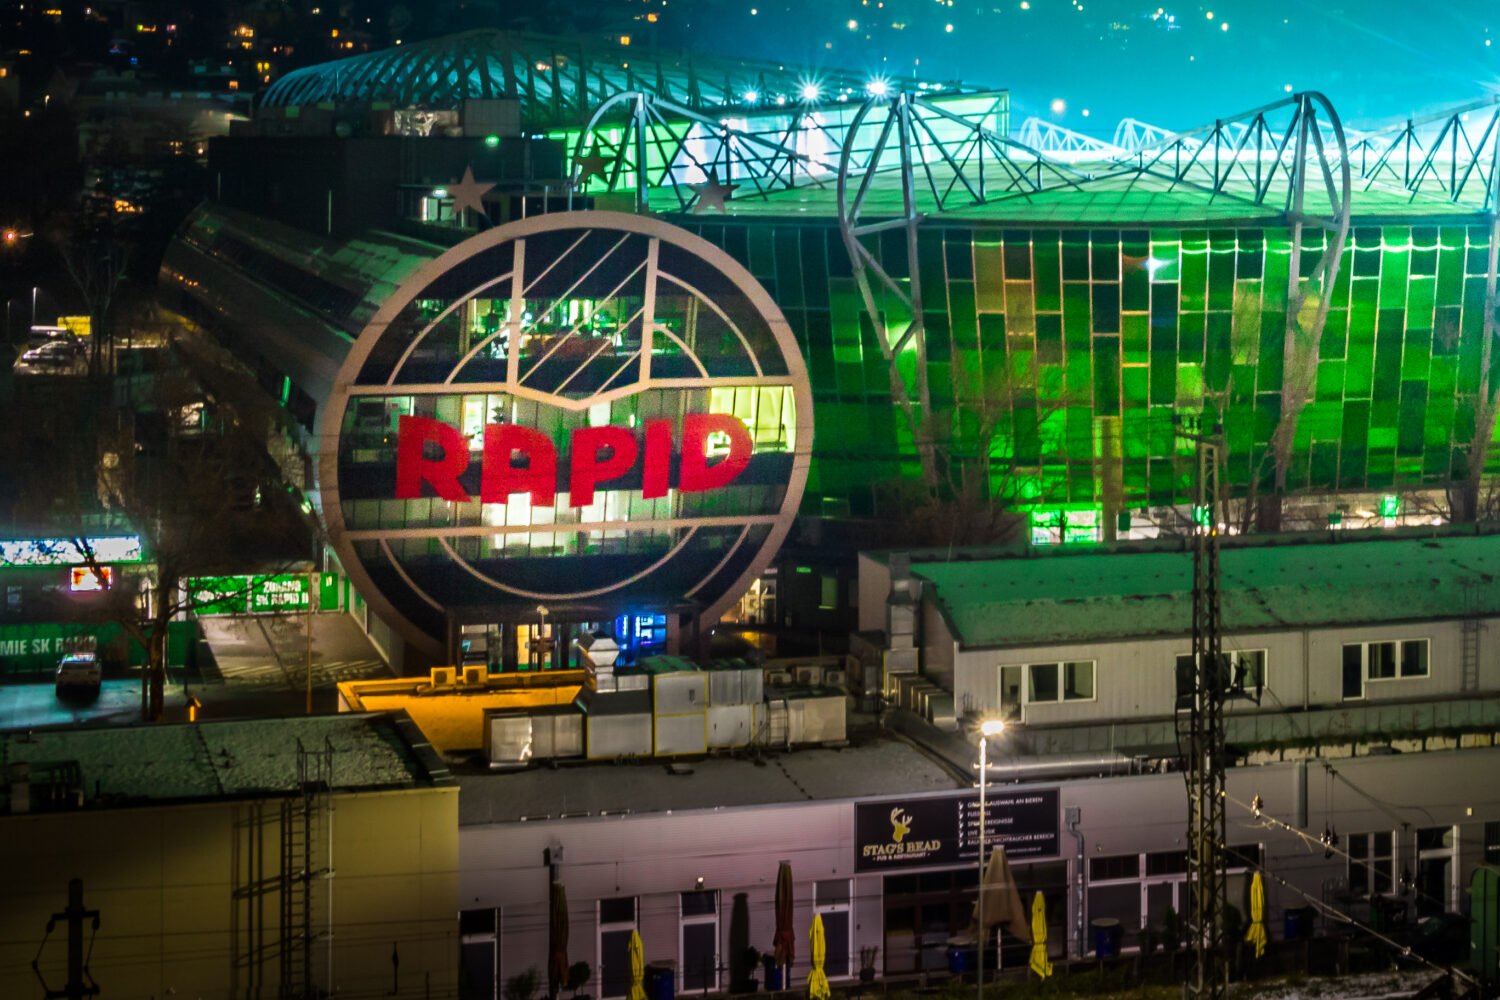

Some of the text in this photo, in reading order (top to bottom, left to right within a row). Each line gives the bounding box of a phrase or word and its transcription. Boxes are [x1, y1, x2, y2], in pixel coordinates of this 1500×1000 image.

[394, 413, 754, 508] RAPID
[255, 594, 269, 606] SK
[271, 592, 299, 605] RAPID
[32, 638, 50, 654] SK
[863, 840, 941, 857] STAG'S HEAD
